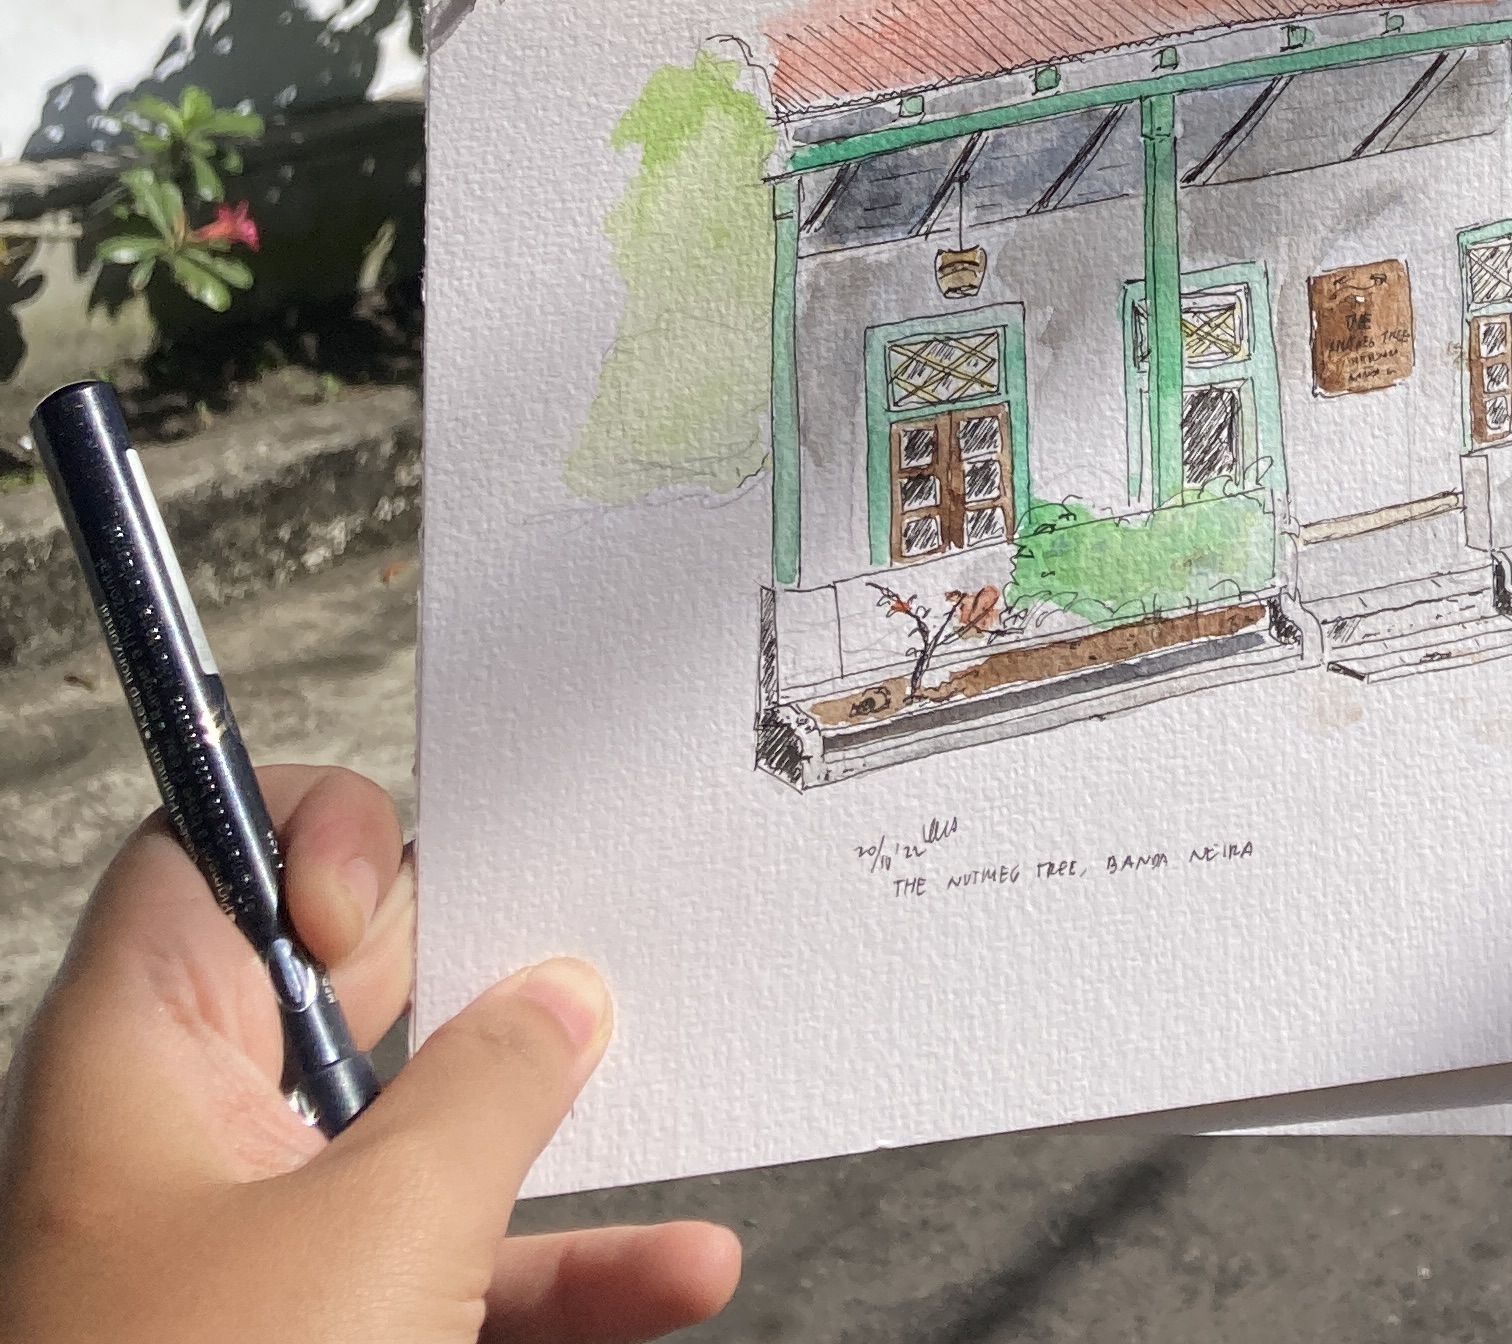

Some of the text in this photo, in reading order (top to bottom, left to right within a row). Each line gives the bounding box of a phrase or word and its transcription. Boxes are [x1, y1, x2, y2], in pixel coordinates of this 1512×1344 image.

[893, 877, 926, 897] THE
[946, 863, 1020, 889] NUTMEG
[1106, 853, 1169, 874] BANDA
[1189, 841, 1253, 863] NEIRA
